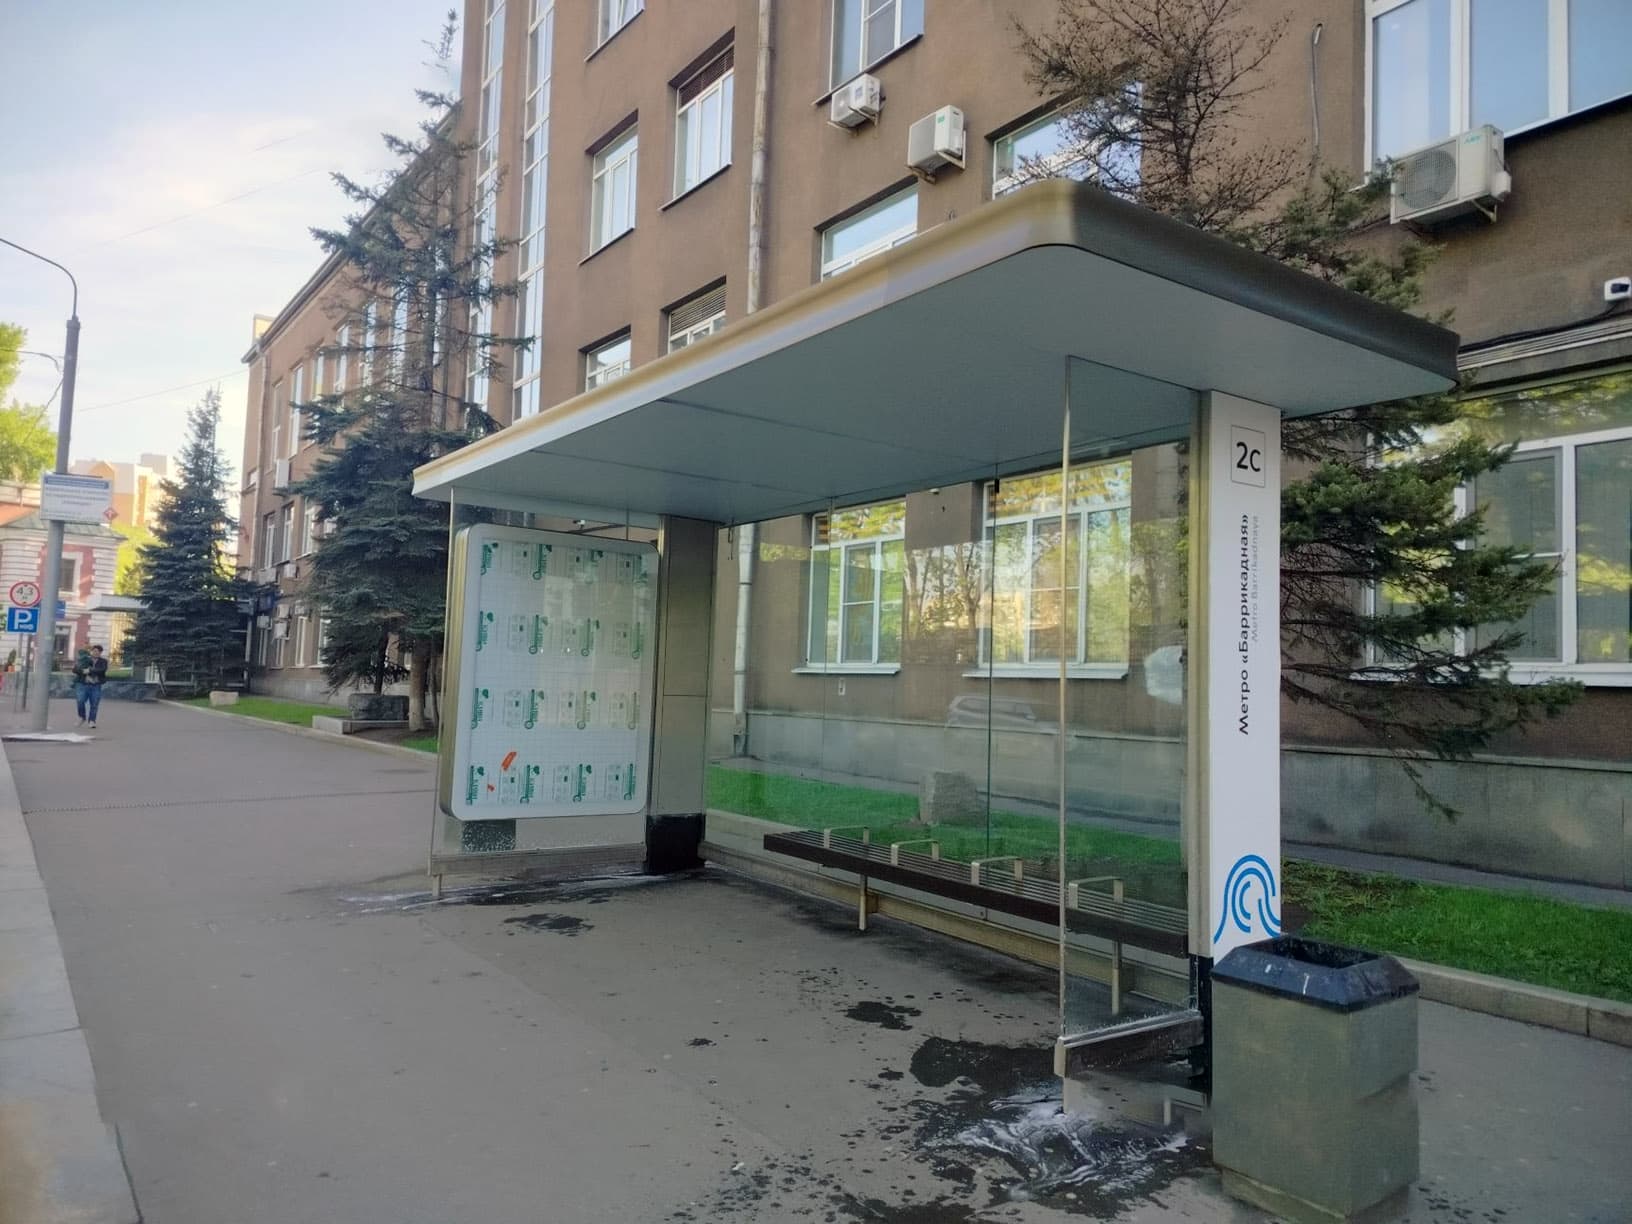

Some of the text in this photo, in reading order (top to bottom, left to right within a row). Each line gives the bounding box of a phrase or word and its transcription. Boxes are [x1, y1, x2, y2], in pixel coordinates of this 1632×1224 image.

[1238, 514, 1251, 735] Метро «Баррикадная»
[1251, 515, 1259, 600] Barrikadnaya
